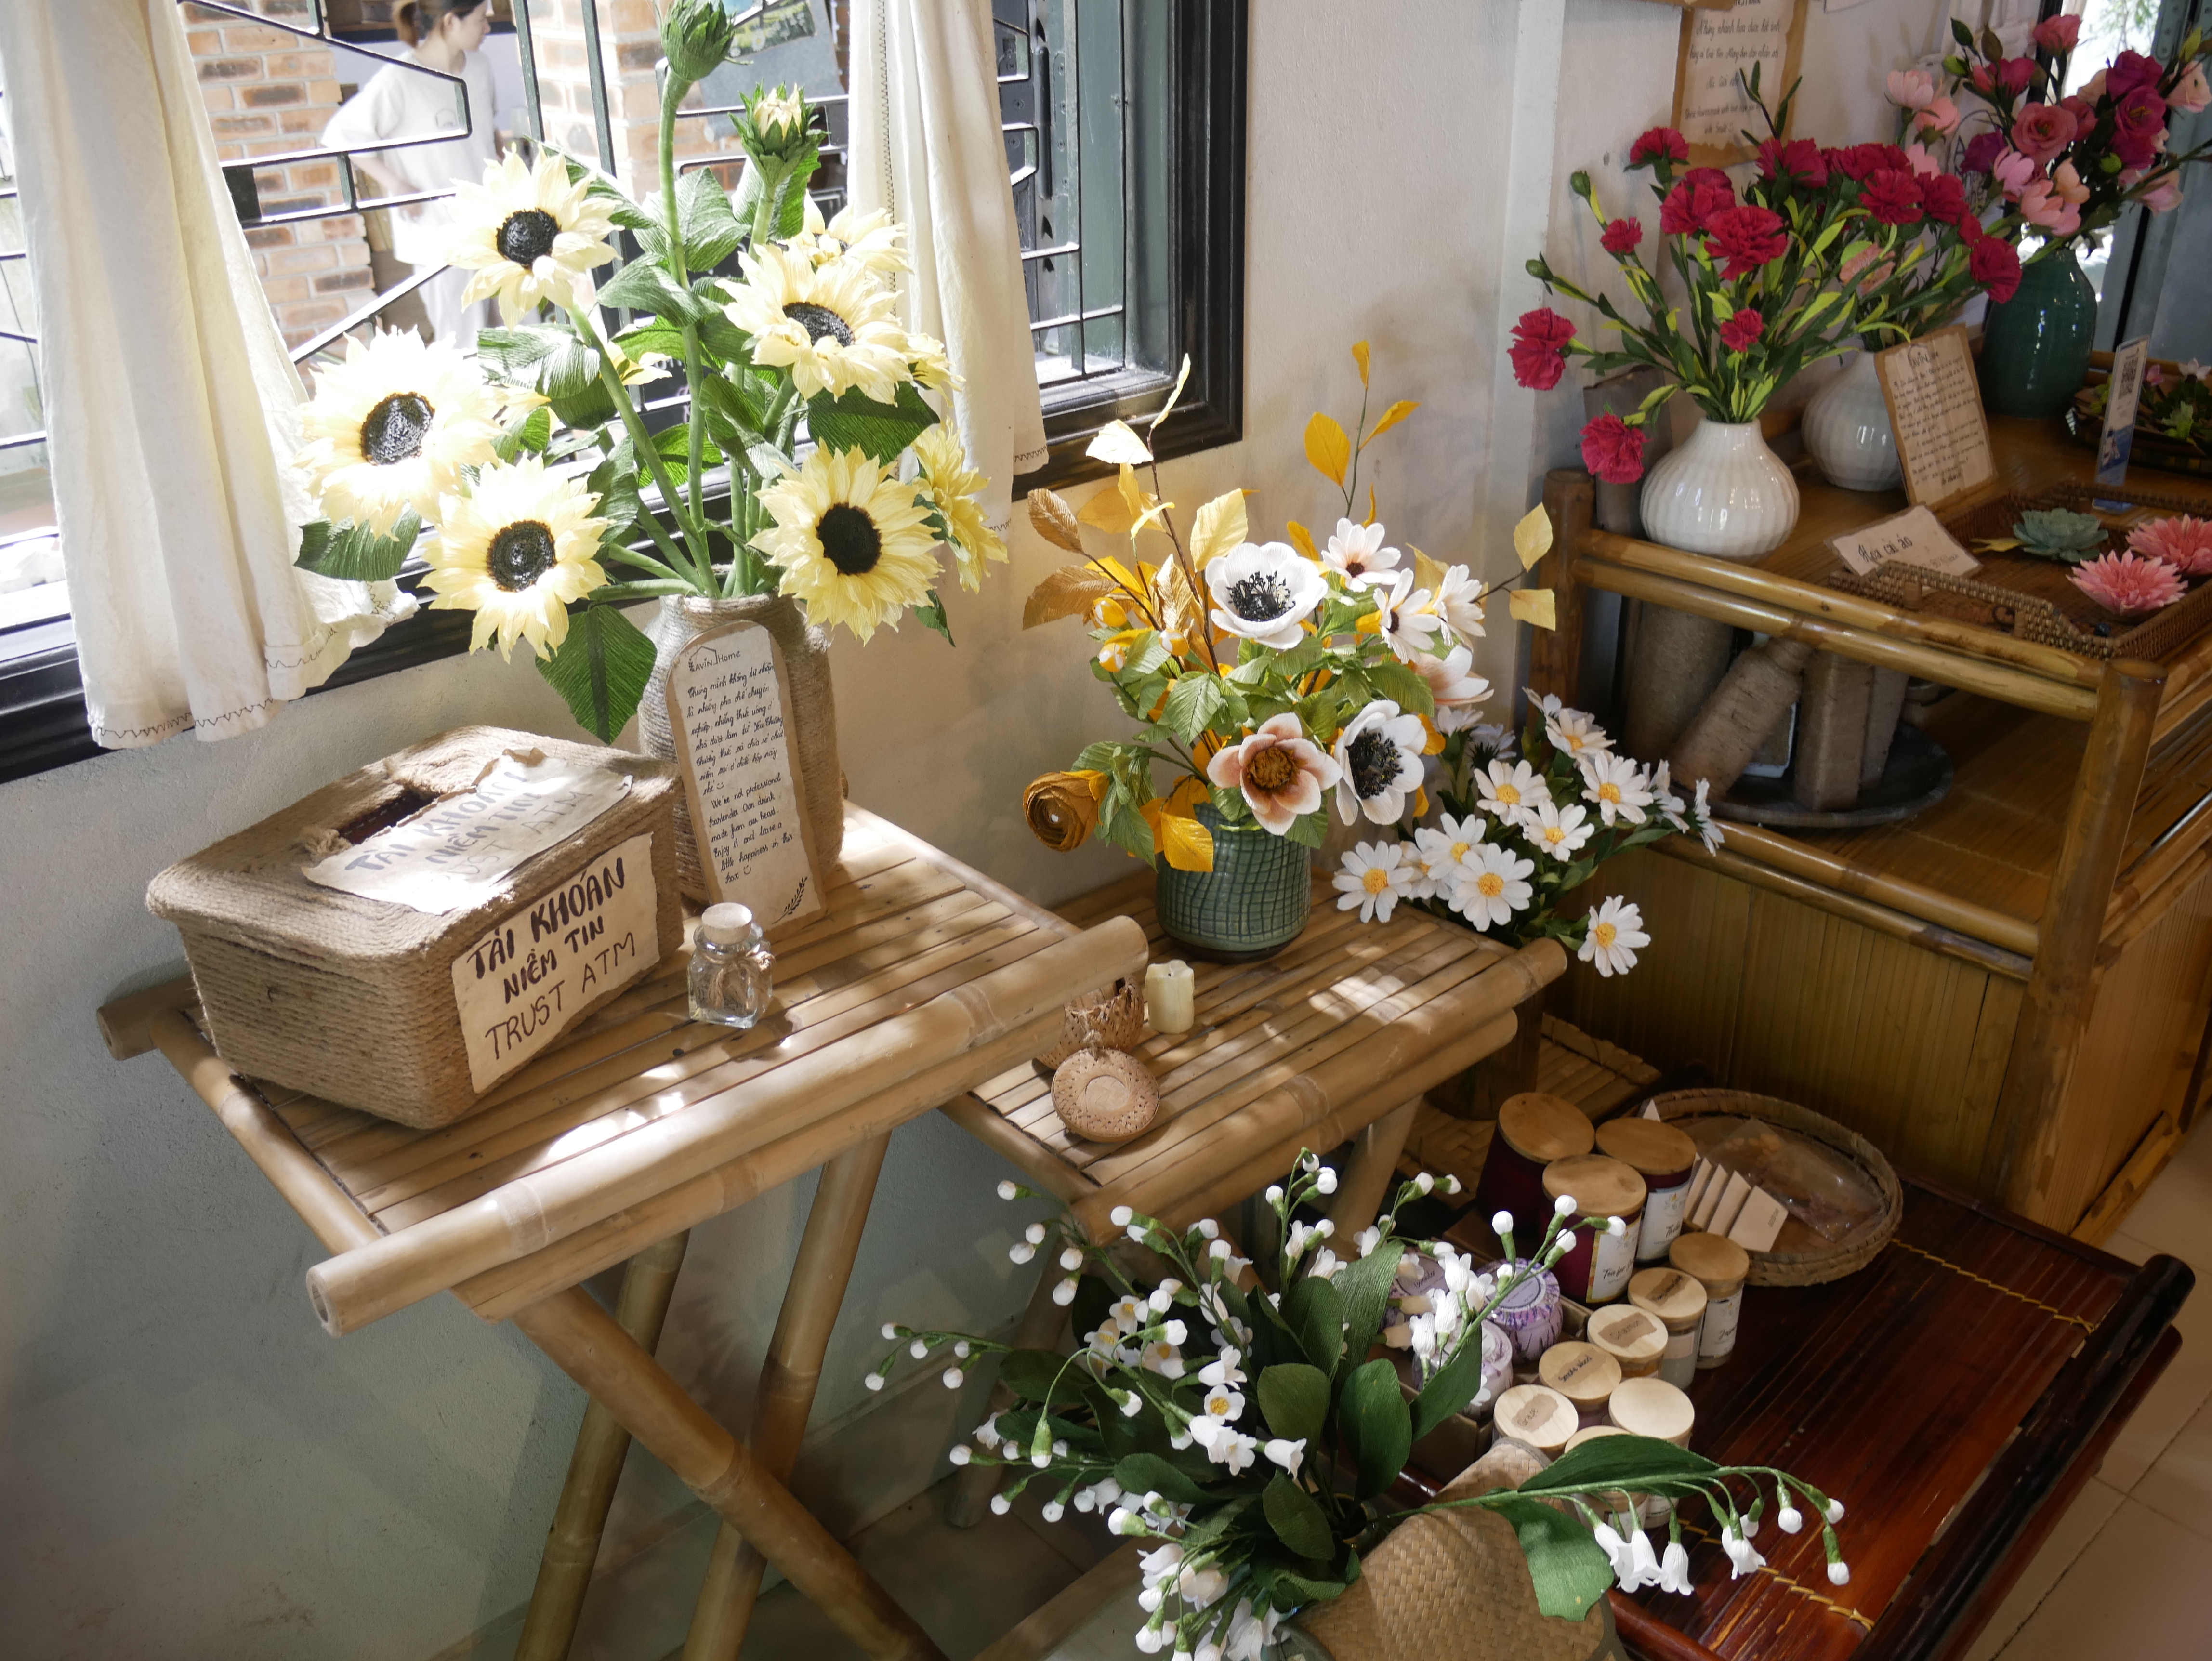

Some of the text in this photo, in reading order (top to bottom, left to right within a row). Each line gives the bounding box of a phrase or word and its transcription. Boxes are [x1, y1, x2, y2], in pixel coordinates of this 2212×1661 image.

[718, 650, 740, 663] Home
[729, 673, 747, 687] không
[720, 697, 731, 710] pha
[711, 772, 781, 809] We're not professional
[743, 802, 755, 812] Our
[757, 791, 775, 806] drink
[488, 792, 541, 822] TIN
[521, 791, 594, 835] ATM
[711, 830, 728, 843] made
[731, 823, 745, 838] from
[713, 845, 730, 858] Enjoy
[733, 838, 738, 848] it
[743, 830, 755, 844] and
[739, 845, 769, 863] happiness
[772, 839, 778, 848] in
[781, 832, 793, 844] this
[564, 915, 604, 953] TIN
[485, 932, 635, 1060] TRUST ATM
